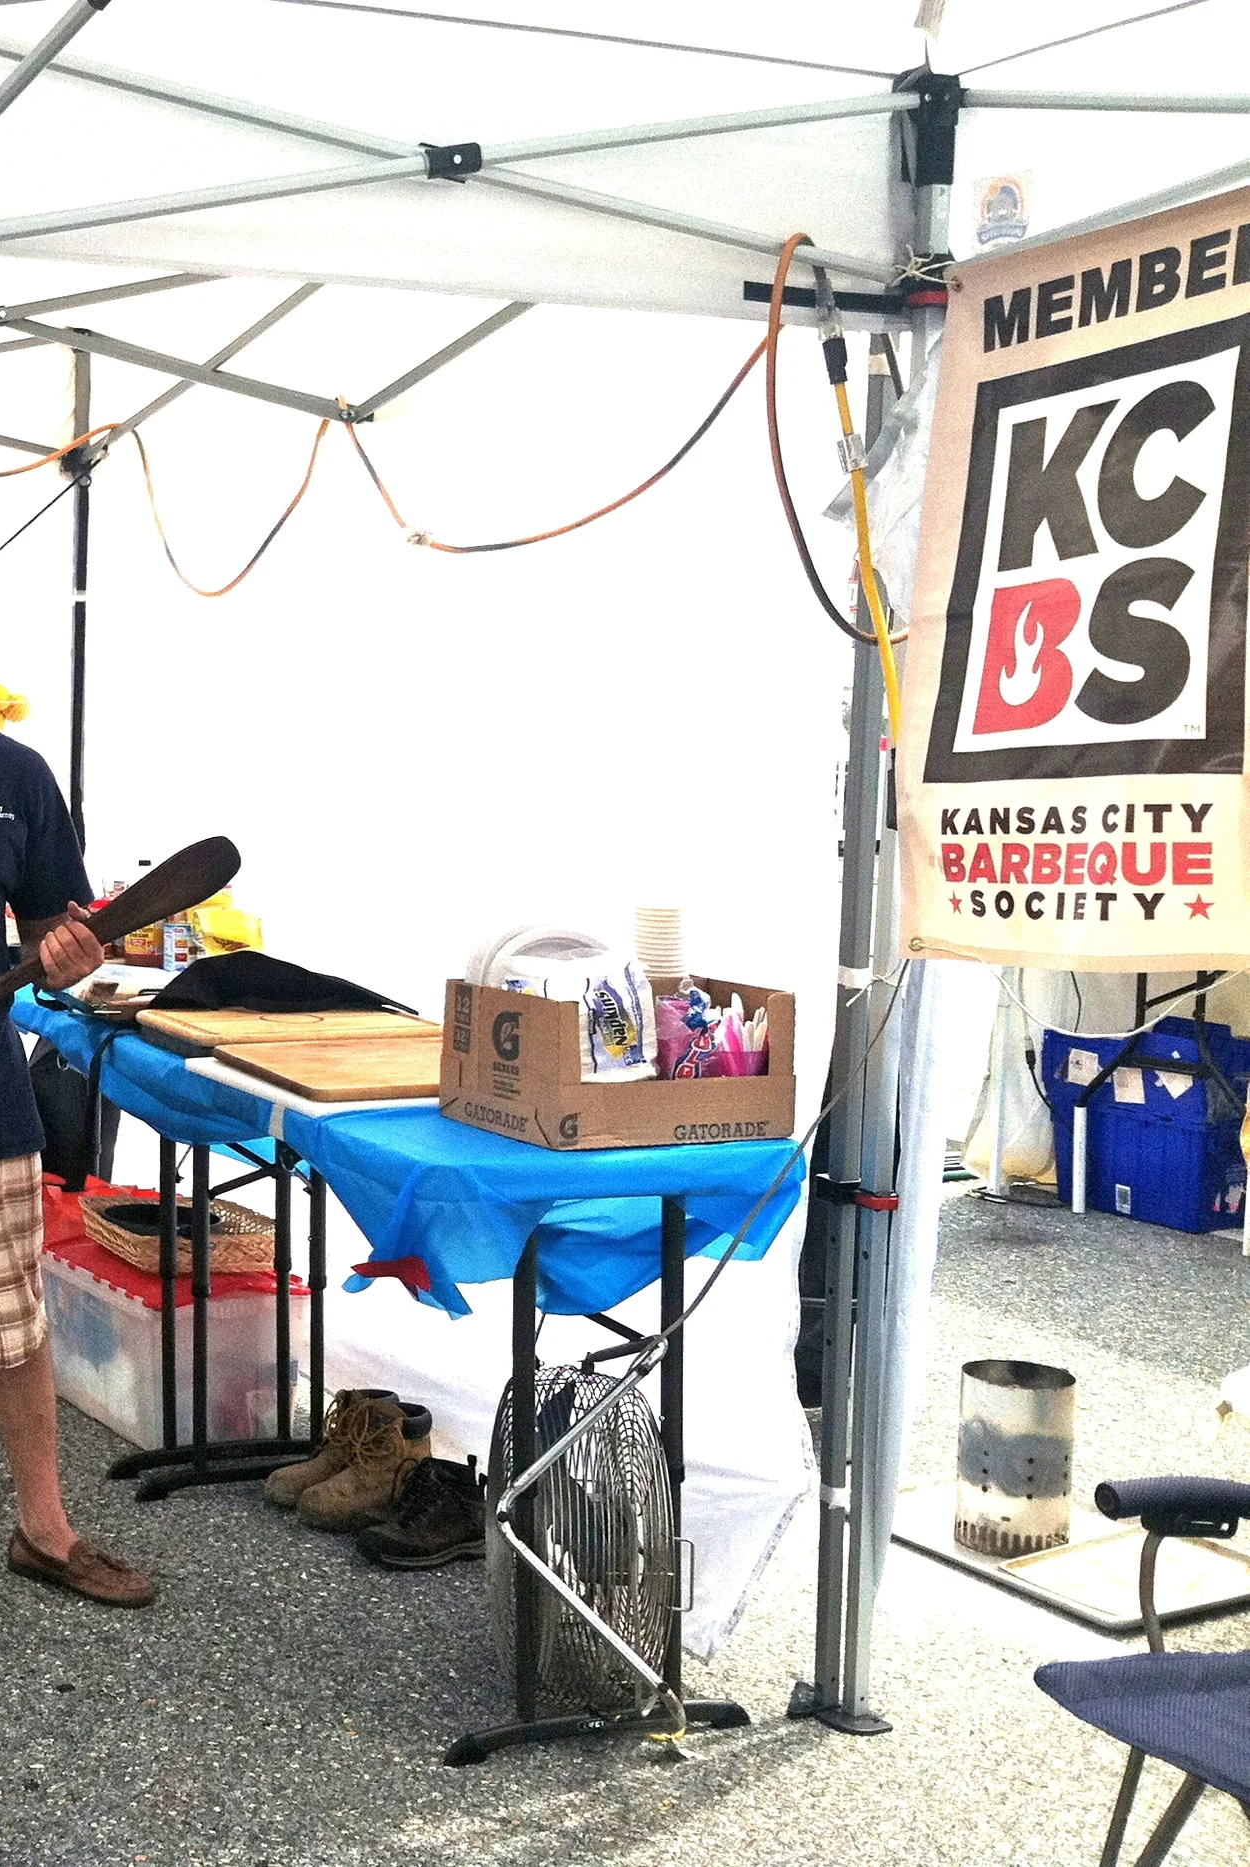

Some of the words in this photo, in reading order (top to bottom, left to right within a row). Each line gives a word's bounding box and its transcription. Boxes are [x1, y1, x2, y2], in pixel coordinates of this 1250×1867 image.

[941, 805, 1087, 835] KANSAS
[1102, 803, 1214, 833] CITY
[941, 842, 1214, 886] BARBEQUE
[971, 890, 1166, 921] SOCIETY
[595, 991, 628, 1046] Napkins
[464, 1102, 528, 1133] GATORADE
[674, 1121, 767, 1140] GATORADE
